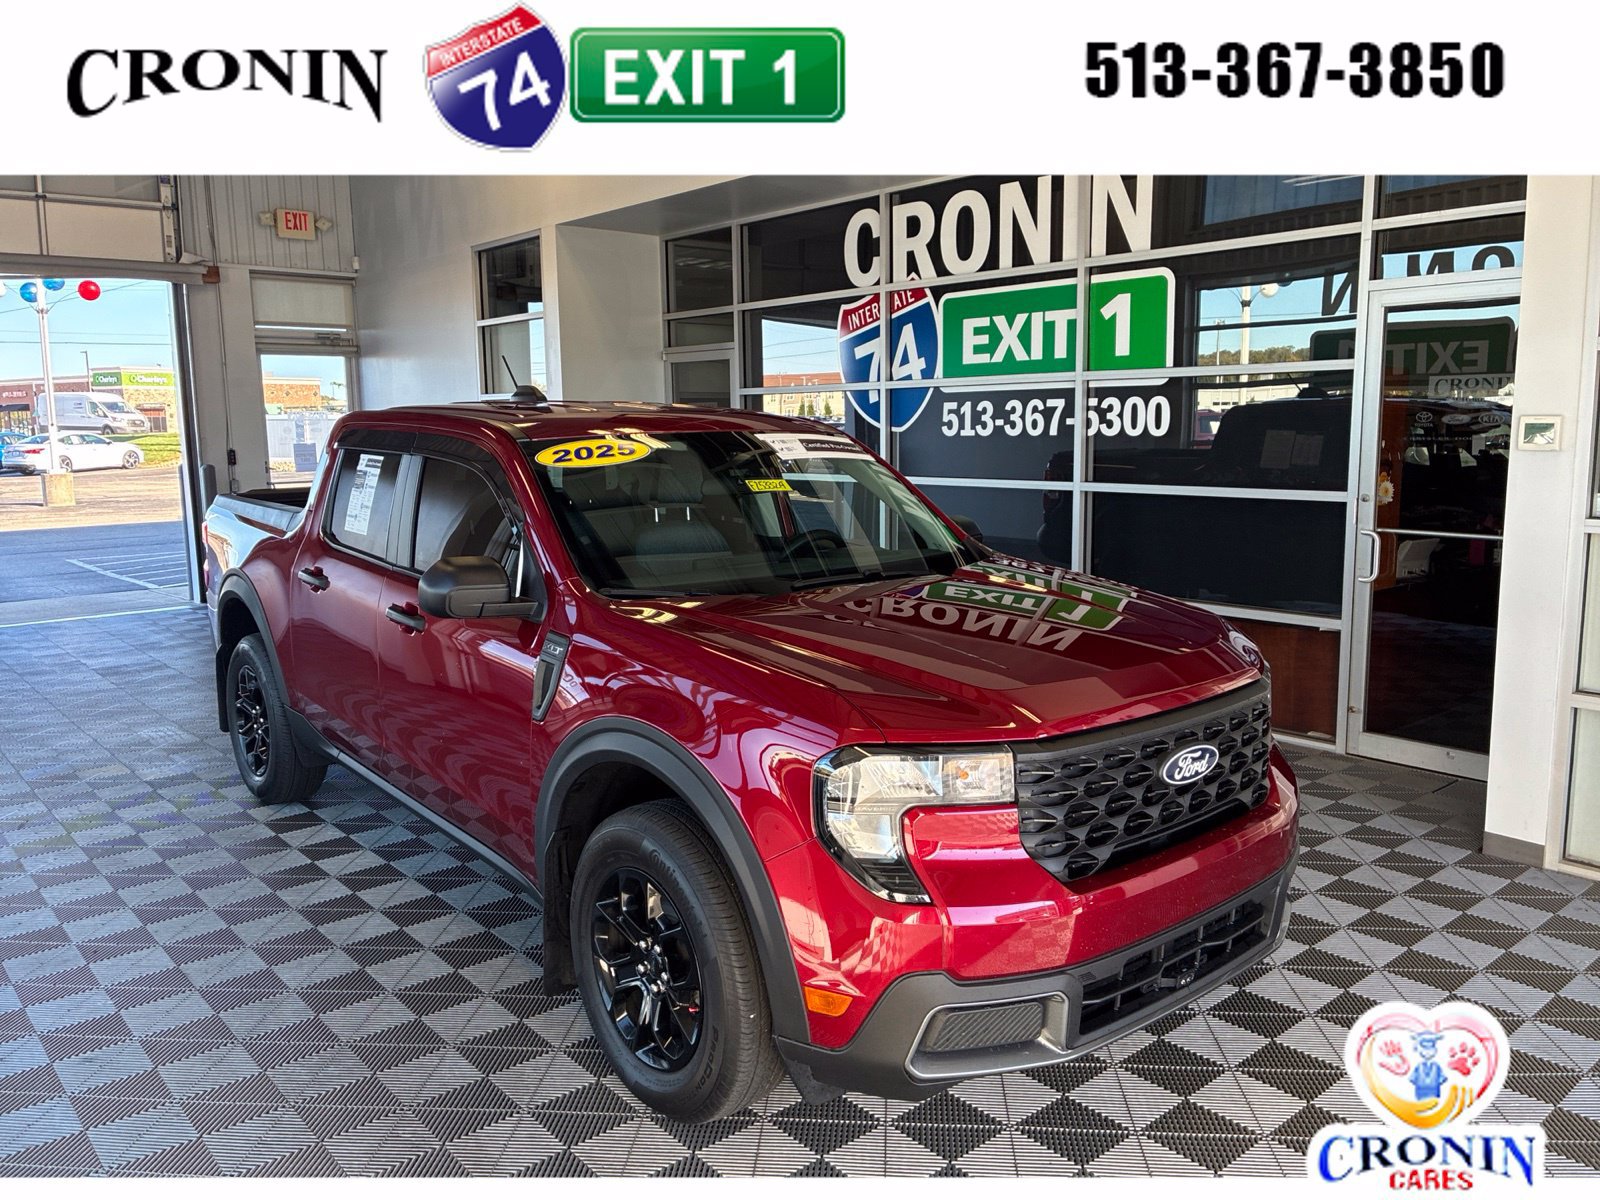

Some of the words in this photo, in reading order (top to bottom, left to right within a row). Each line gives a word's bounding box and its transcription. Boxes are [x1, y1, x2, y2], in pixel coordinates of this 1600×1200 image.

[284, 211, 309, 231] EXIT
[844, 175, 1153, 288] CRONIN
[962, 308, 1077, 365] EXIT
[1100, 293, 1131, 357] 1
[854, 322, 926, 404] 74
[941, 396, 1171, 437] 513-367-5300
[552, 443, 637, 464] 2025
[1174, 750, 1209, 780] Ford
